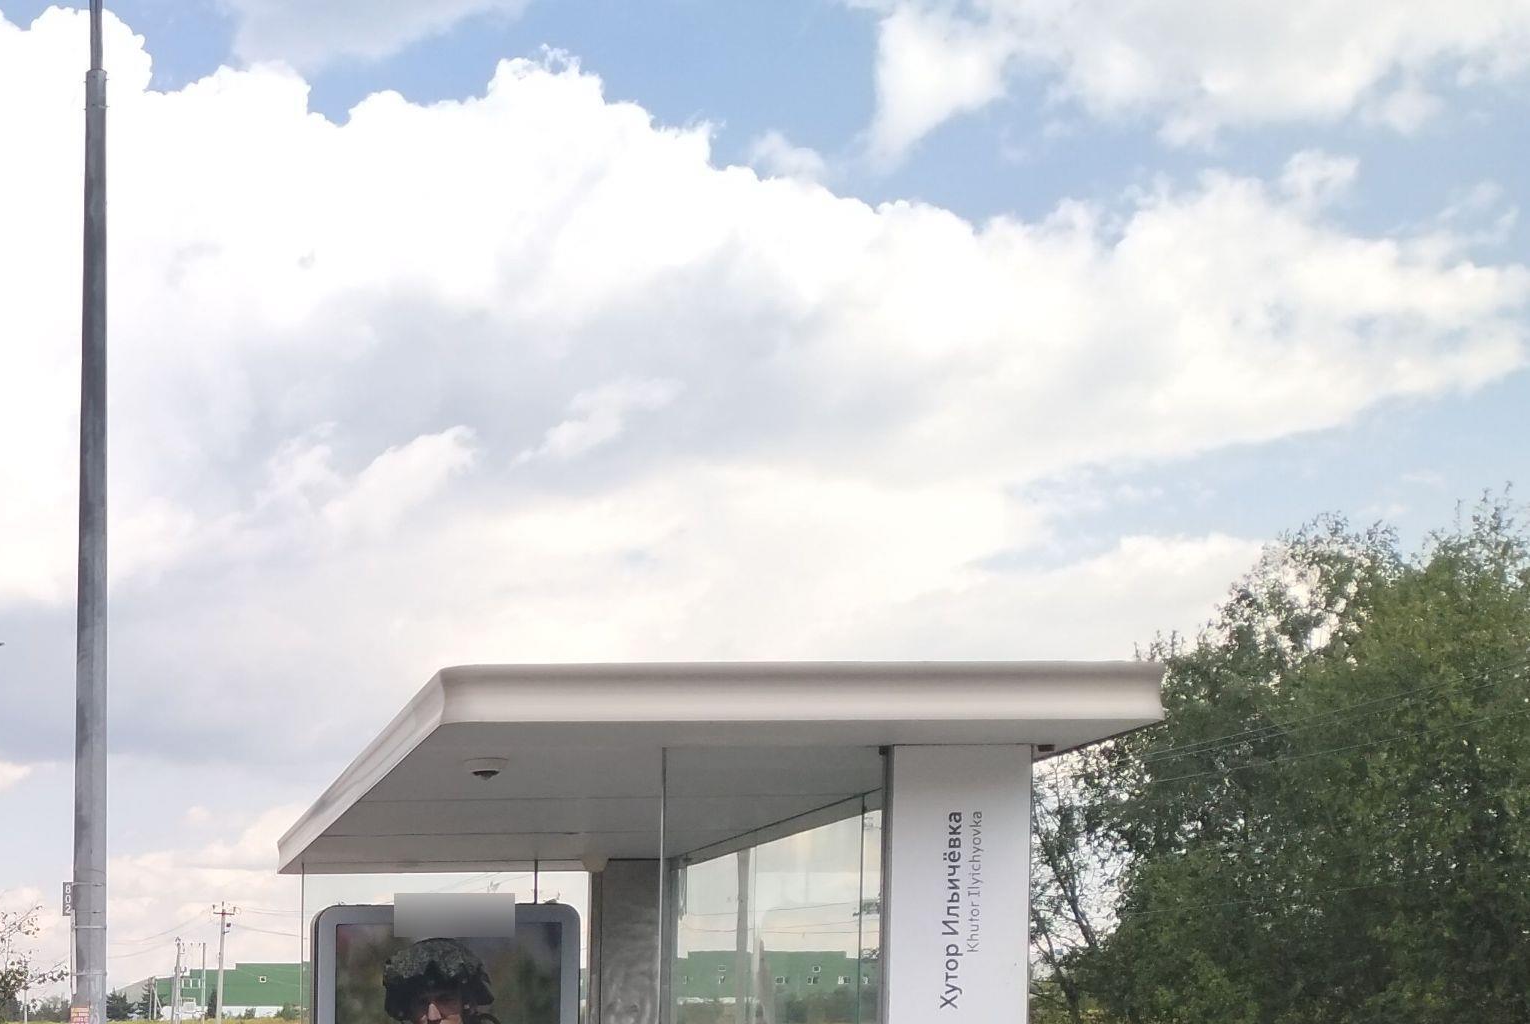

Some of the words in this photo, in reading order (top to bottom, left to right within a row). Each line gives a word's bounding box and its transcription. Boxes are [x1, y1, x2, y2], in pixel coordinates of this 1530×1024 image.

[942, 811, 963, 936] Ильичёвка
[967, 811, 985, 896] Ilyichyovka
[967, 902, 980, 952] Khutor
[939, 943, 964, 1010] Хутор
